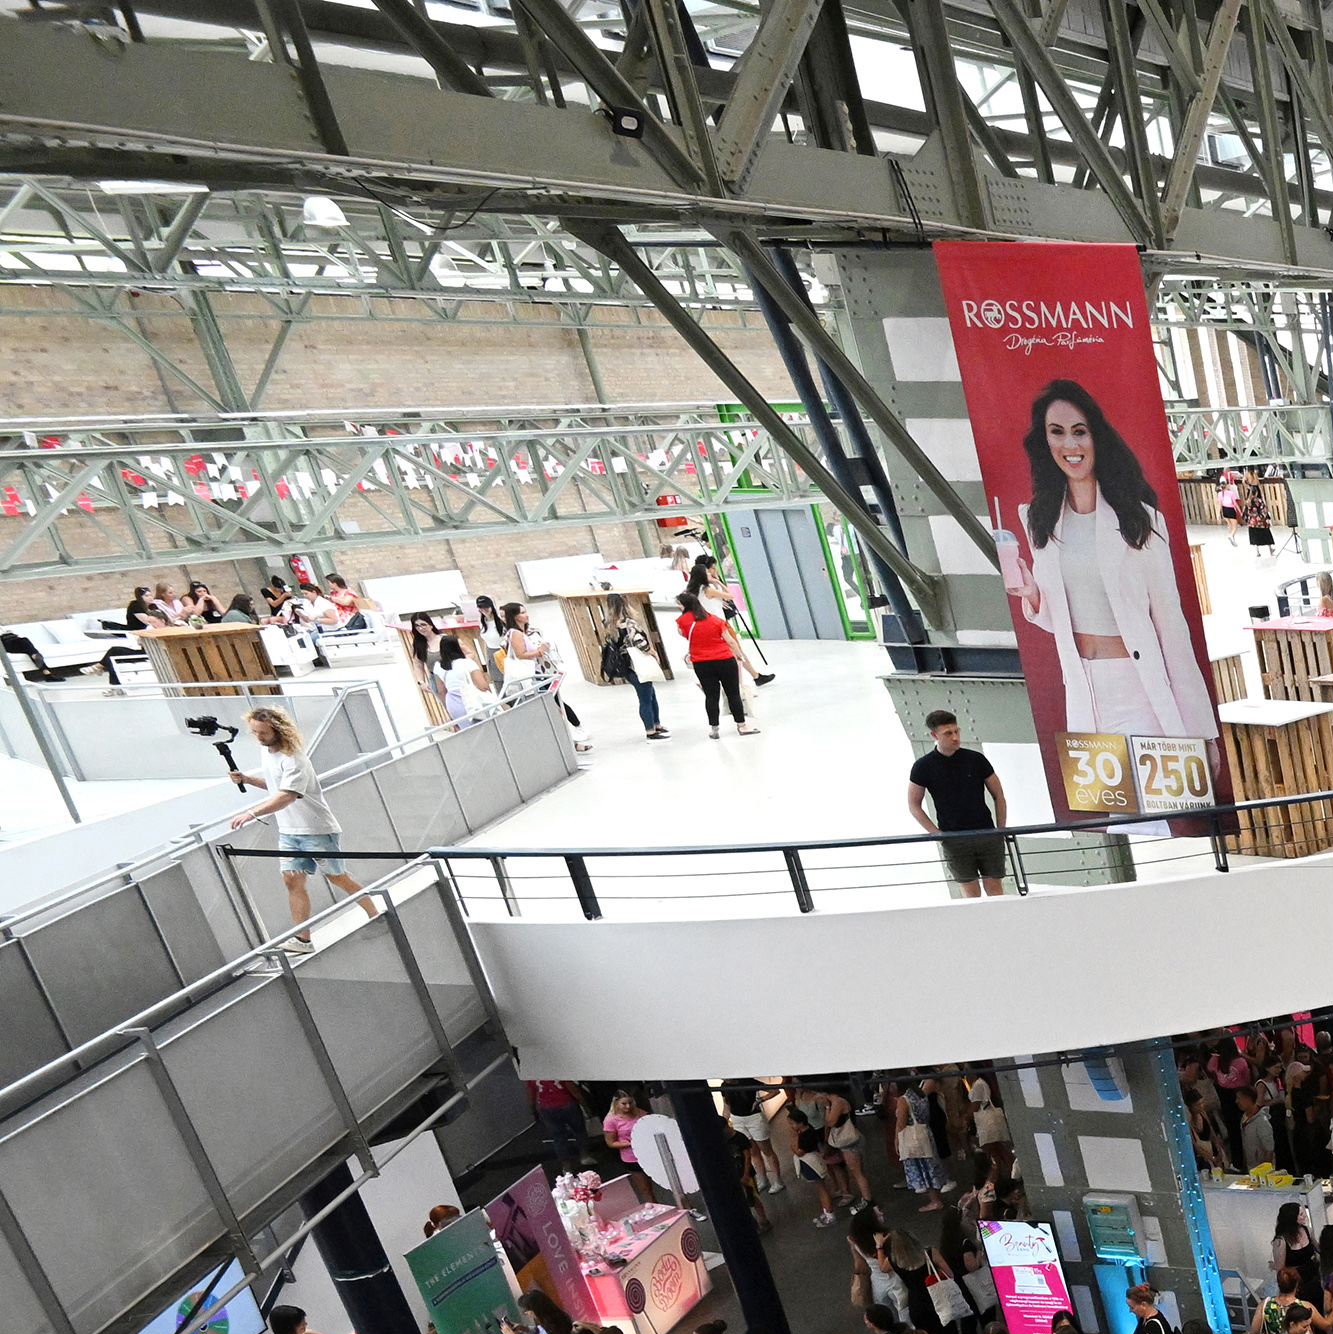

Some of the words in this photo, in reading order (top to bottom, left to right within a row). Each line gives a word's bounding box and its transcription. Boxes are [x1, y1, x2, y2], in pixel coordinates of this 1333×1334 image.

[961, 299, 1134, 329] ROSSMANN
[1066, 739, 1117, 750] ROSSMANN
[1140, 742, 1156, 751] MÁR
[1179, 743, 1197, 752] MINT
[1069, 750, 1123, 787] 30
[1139, 753, 1208, 798] 250
[1076, 784, 1128, 807] éves
[541, 1221, 569, 1275] LOVE
[424, 1276, 442, 1290] THE
